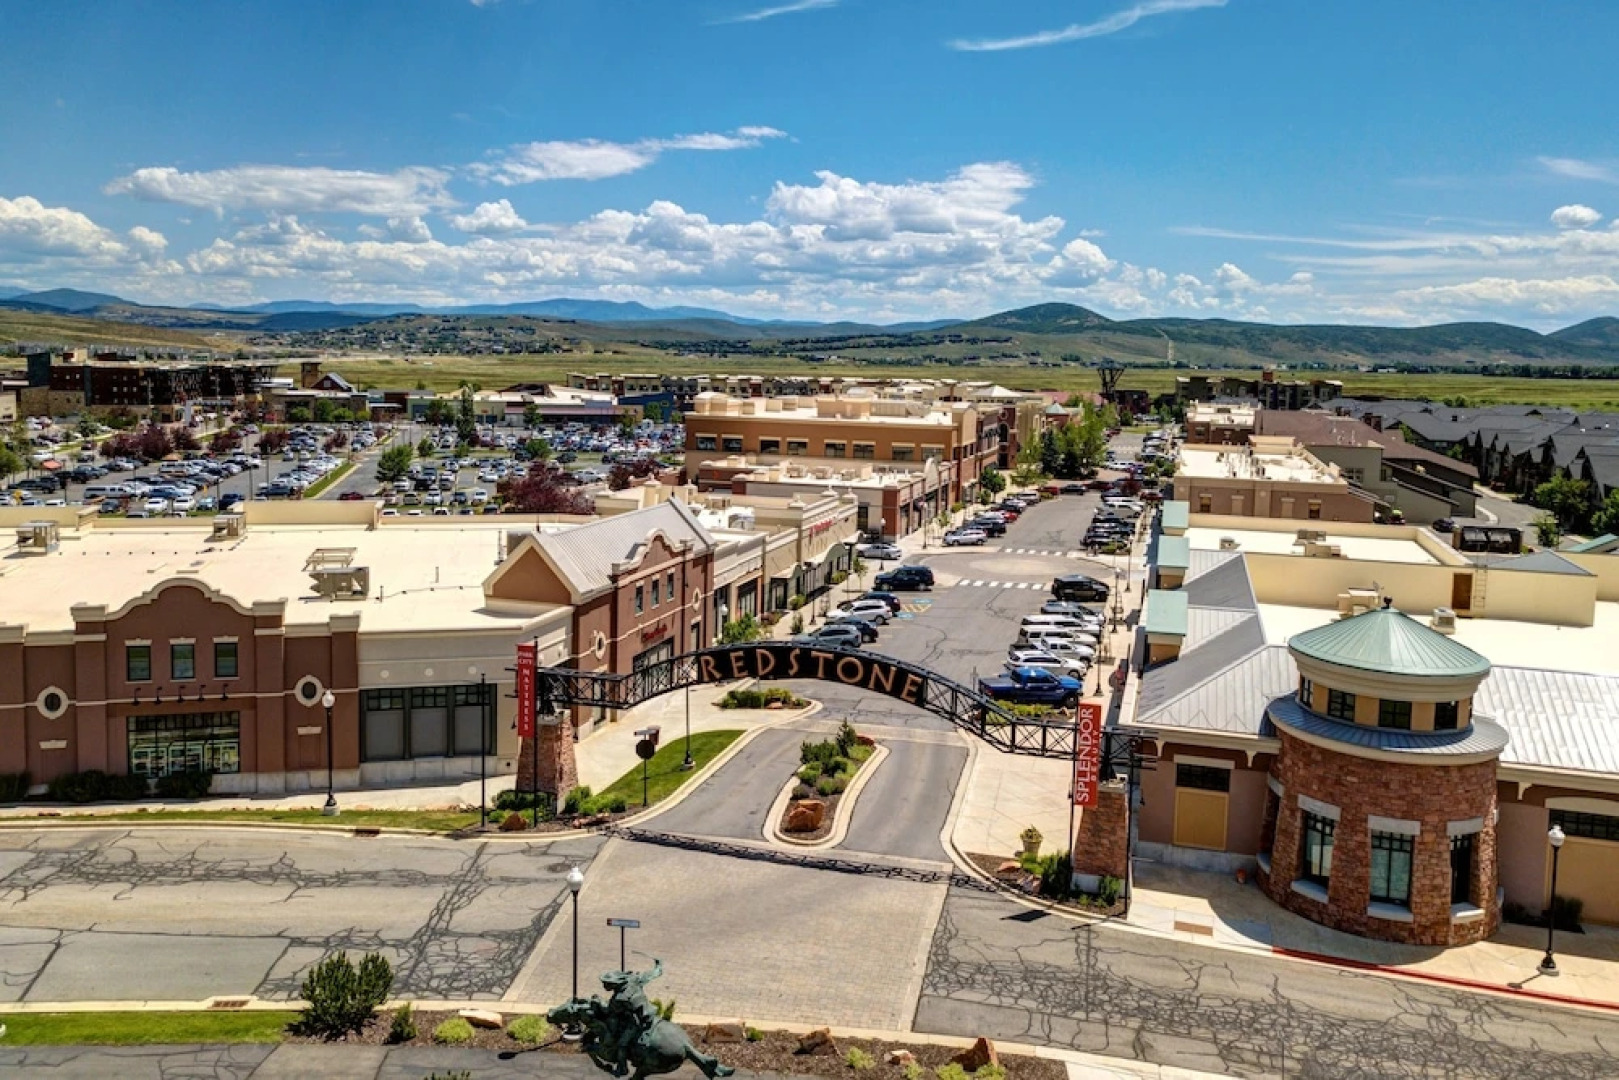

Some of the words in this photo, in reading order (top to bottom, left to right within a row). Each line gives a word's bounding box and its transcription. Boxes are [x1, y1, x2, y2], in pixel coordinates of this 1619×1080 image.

[522, 668, 530, 731] MATTRESS
[700, 648, 923, 702] REDSTONE
[1076, 708, 1094, 802] SPLENDOR
[1090, 730, 1099, 781] BEAUTY
